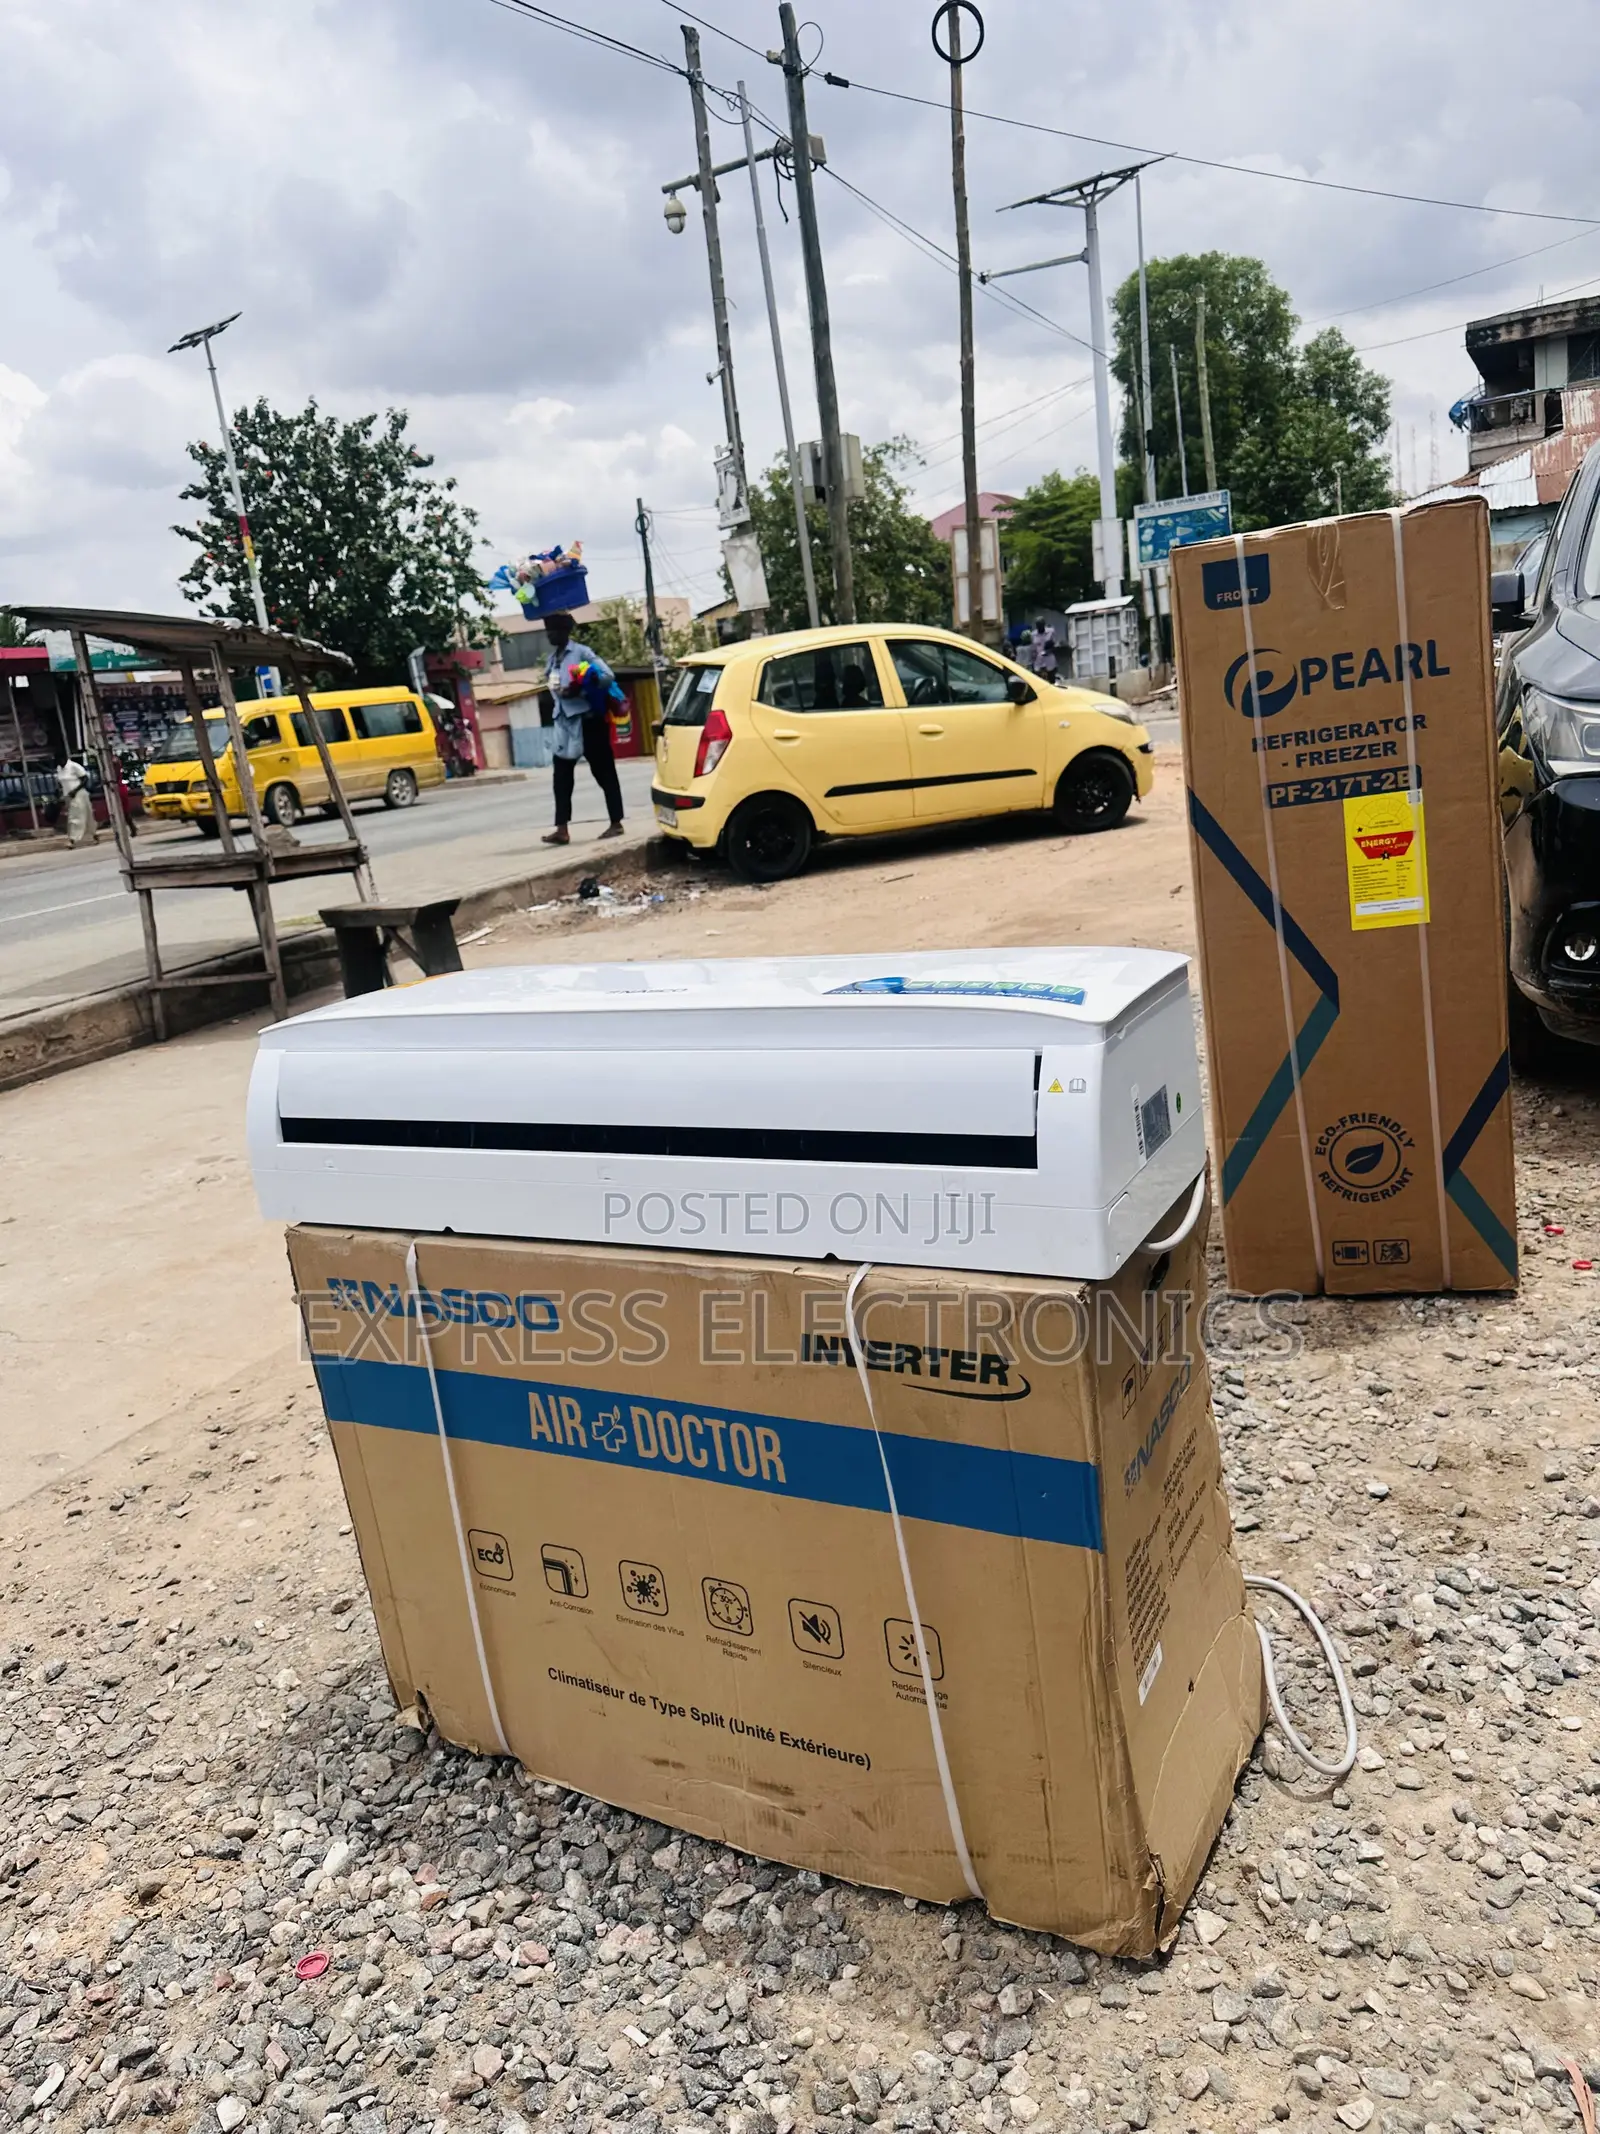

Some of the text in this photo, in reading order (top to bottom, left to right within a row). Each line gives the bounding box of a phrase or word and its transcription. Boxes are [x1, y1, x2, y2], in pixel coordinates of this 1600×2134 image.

[1216, 587, 1259, 604] FROT
[1300, 639, 1451, 696] PEARL
[1252, 714, 1428, 753] REFRIGERATOR
[1295, 741, 1398, 769] FREEZER
[1360, 836, 1398, 848] ENERGY
[1314, 1112, 1416, 1157] ECO-FRIENDLY
[1318, 1167, 1414, 1203] REFRIGERANT
[361, 1280, 560, 1332] NASCO
[801, 1333, 1011, 1387] INVERTER
[528, 1391, 788, 1485] AIR DOCTOR
[477, 1547, 504, 1565] ECO
[549, 1598, 594, 1615] Anti-Corrosion
[652, 1623, 666, 1633] des
[667, 1626, 685, 1637] Virus
[722, 1648, 748, 1662] Rapide
[802, 1660, 842, 1677] Silencieux
[548, 1666, 872, 1771] Climatiseur de Type Split (Unité Extérieure)
